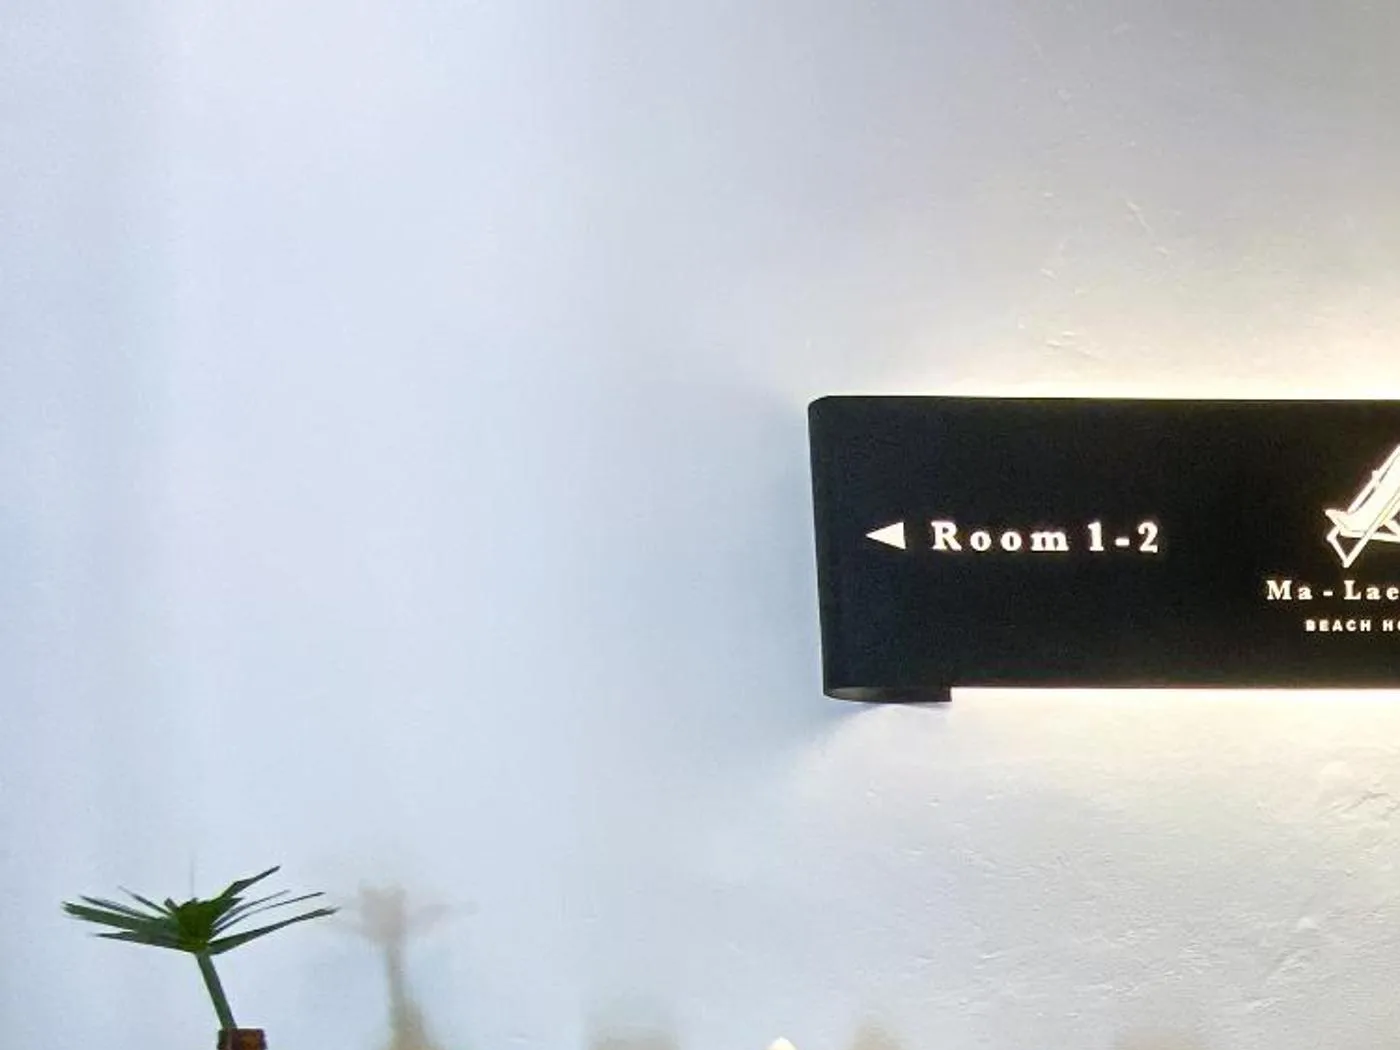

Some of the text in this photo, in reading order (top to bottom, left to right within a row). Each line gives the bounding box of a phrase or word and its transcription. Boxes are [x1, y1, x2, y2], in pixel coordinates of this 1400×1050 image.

[931, 519, 1160, 553] Room 1-2
[1304, 618, 1372, 632] BEACH
